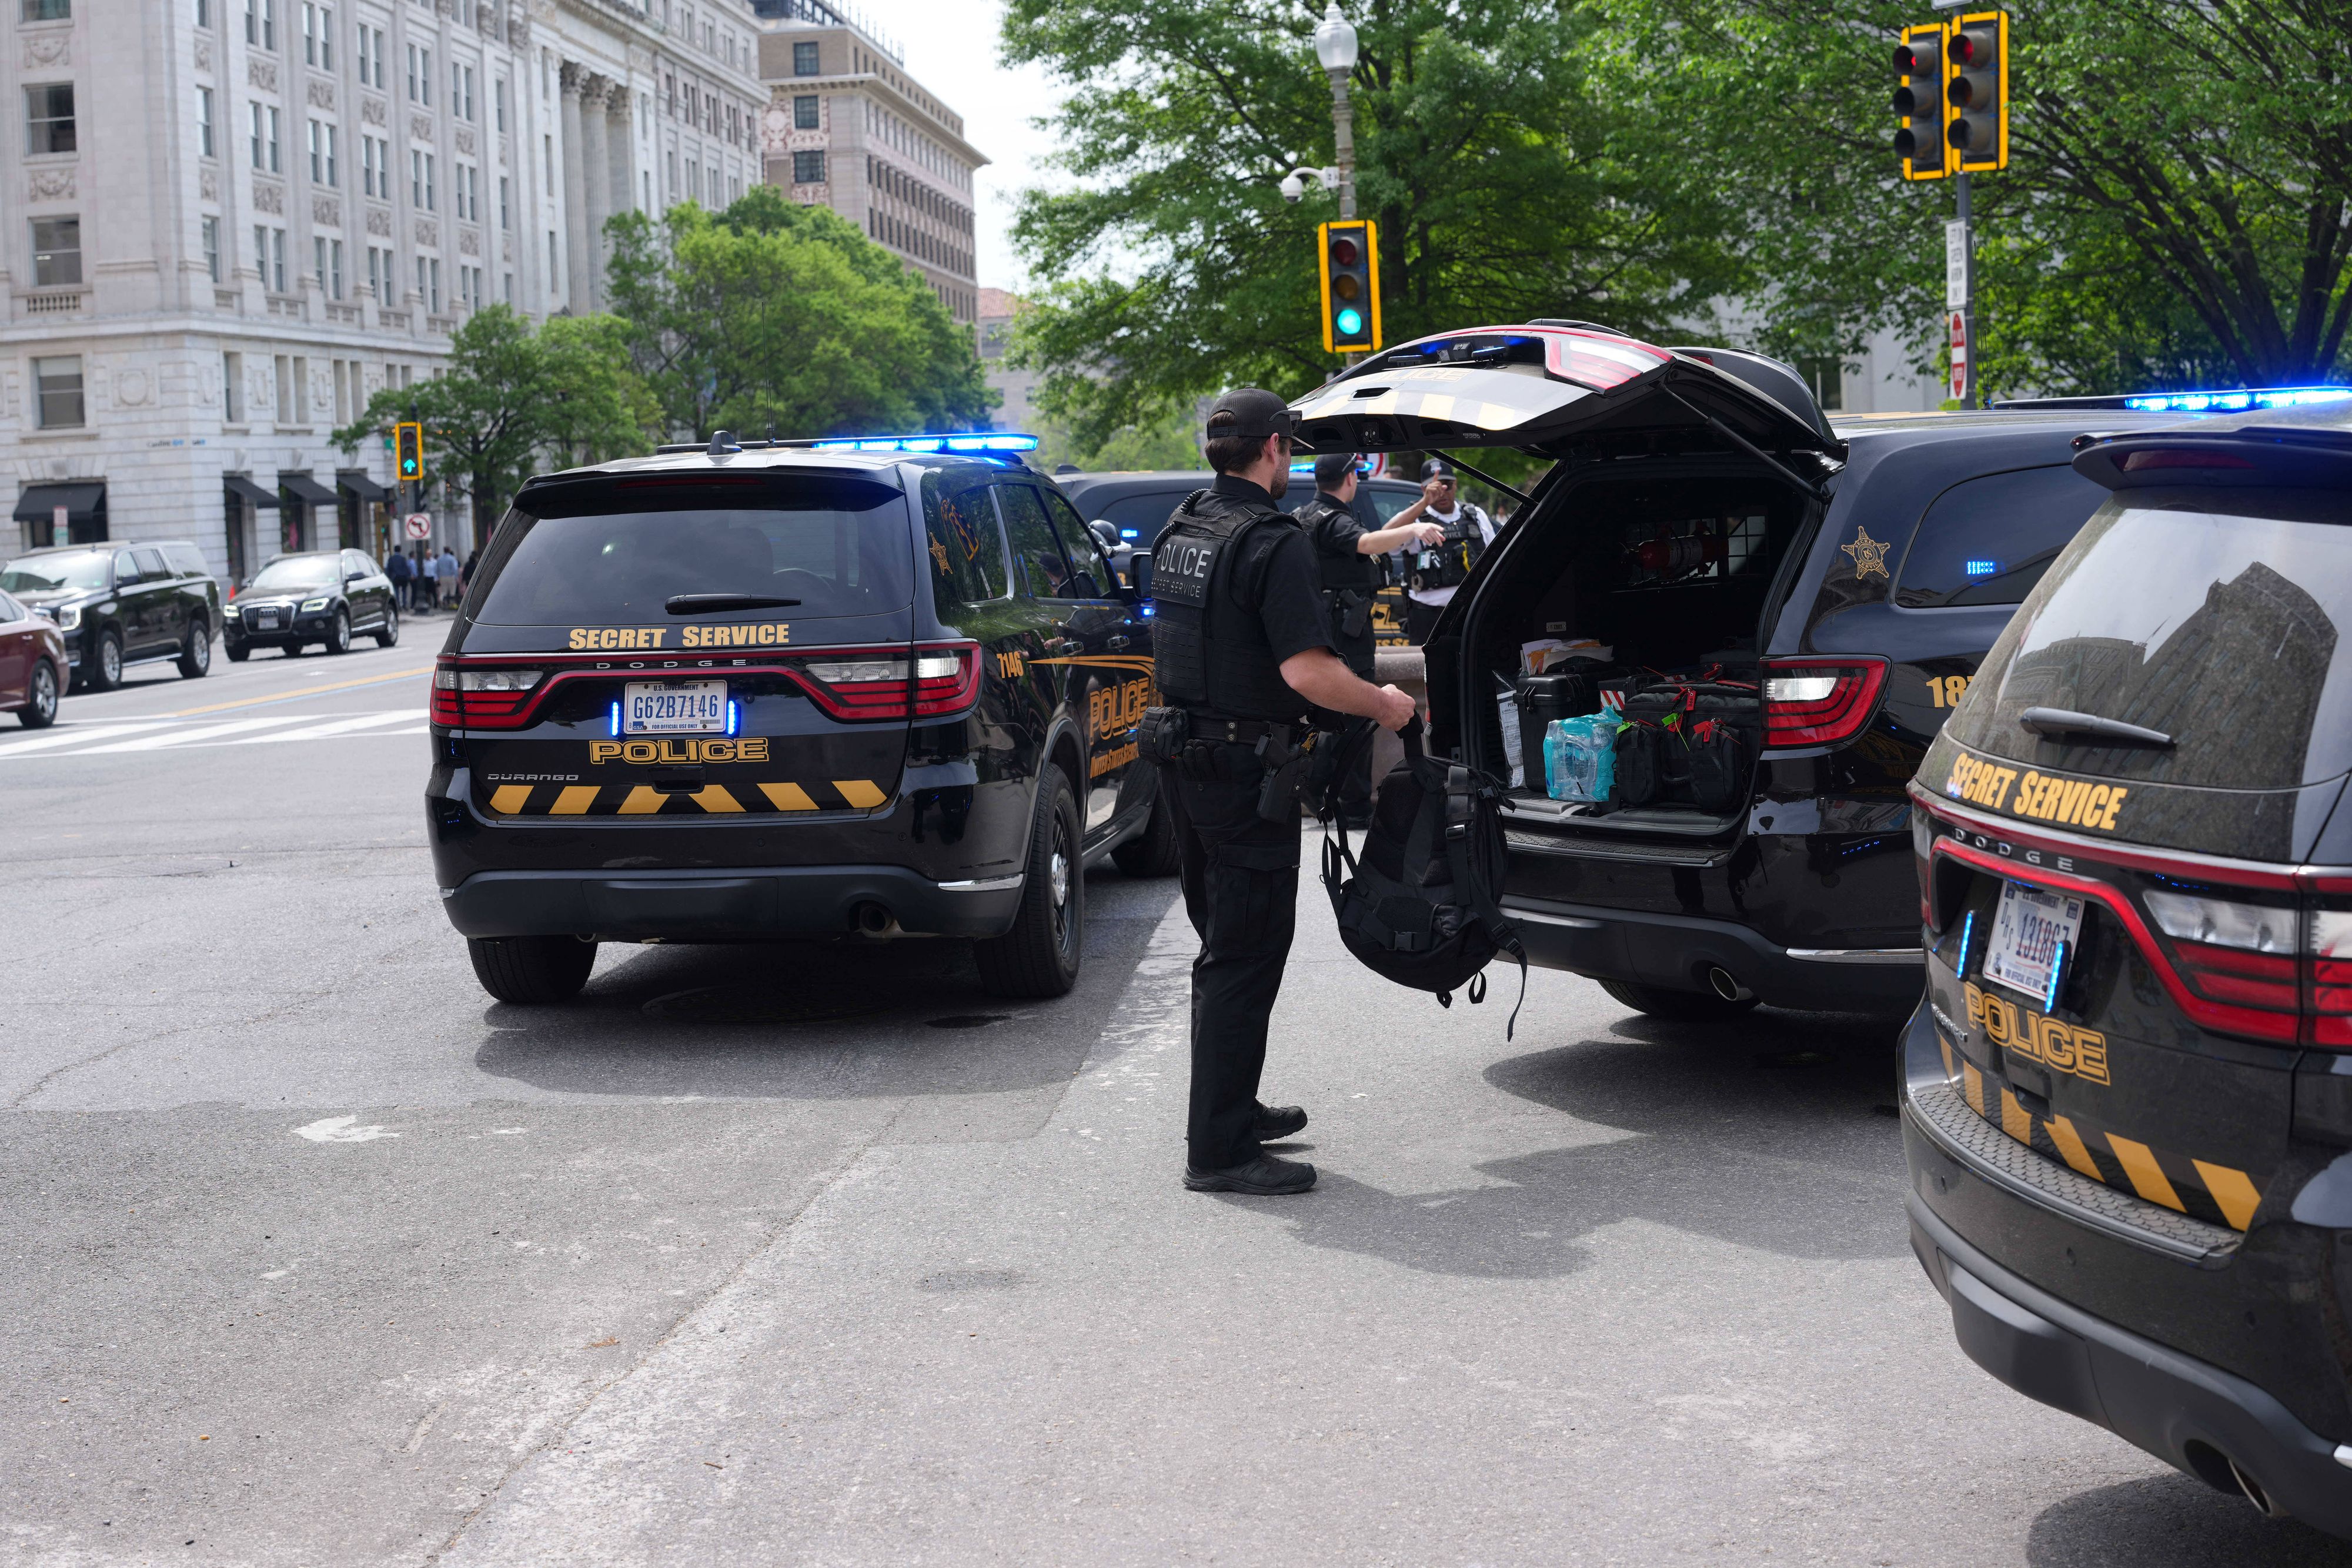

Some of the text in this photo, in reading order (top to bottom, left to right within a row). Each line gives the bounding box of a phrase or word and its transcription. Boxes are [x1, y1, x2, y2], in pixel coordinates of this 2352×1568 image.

[1171, 581, 1201, 598] SERVICE
[569, 624, 789, 650] SECRET SERVICE
[596, 658, 747, 670] DODGE
[996, 650, 1024, 679] 7146
[634, 694, 718, 718] G62B7146
[1926, 675, 1975, 708] 18
[1090, 677, 1150, 747] POLICE
[589, 737, 769, 764] POLICE
[1946, 753, 2127, 831] SECRET SERVICE
[1955, 828, 2073, 872] DODGE
[1965, 981, 2111, 1086] POLICE
